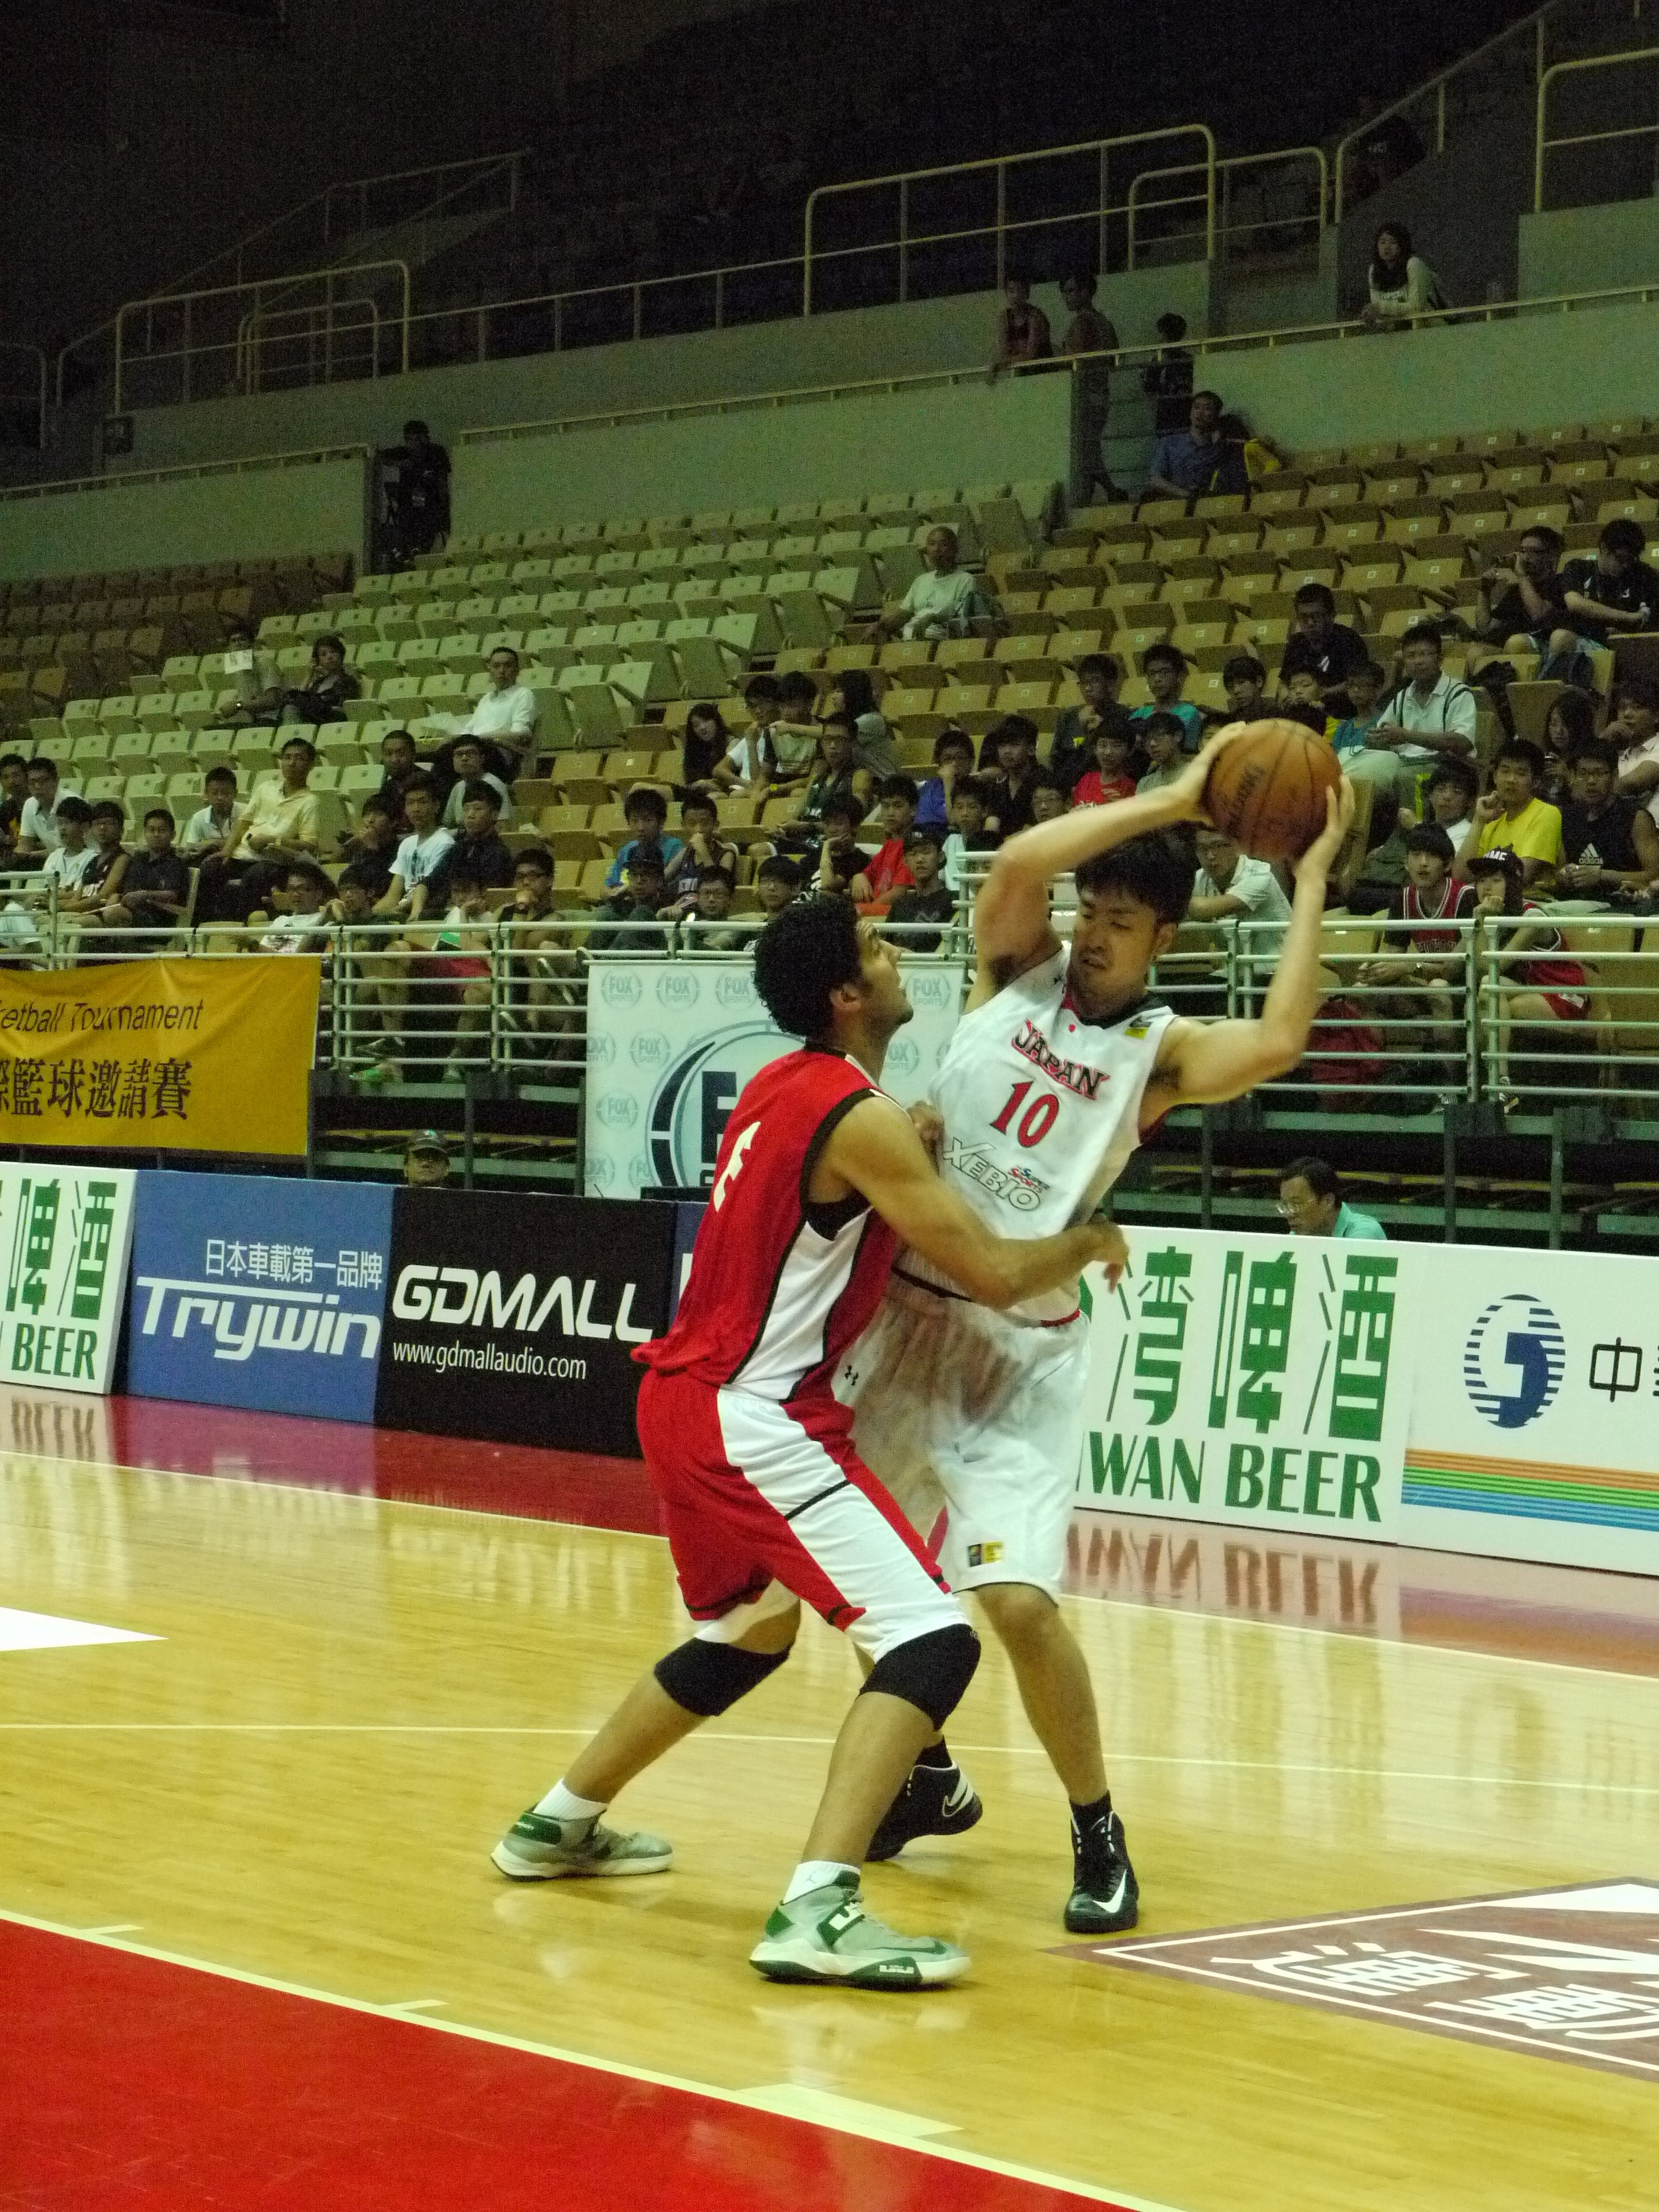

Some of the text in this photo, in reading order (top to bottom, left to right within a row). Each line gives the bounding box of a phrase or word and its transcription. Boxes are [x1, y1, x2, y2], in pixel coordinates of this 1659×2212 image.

[609, 976, 632, 994] FOX
[665, 977, 690, 994] FOX
[724, 977, 751, 994] FOX
[913, 978, 942, 997] FOX
[0, 999, 203, 1032] etball Tournament
[587, 1037, 608, 1053] OX
[639, 1037, 660, 1055] FOX
[888, 1042, 910, 1062] OX
[1011, 1018, 1110, 1100] JAPAN
[989, 1081, 1059, 1148] 10
[585, 1158, 607, 1176] OX
[943, 1136, 1041, 1211] XEBIO
[0, 1178, 117, 1320] 啤酒
[205, 1239, 383, 1290] 日本車載第一品牌
[137, 1276, 381, 1360] Trywin
[392, 1264, 653, 1343] GDMALL
[12, 1323, 98, 1380] BEER
[393, 1340, 587, 1380] www.gdmallaudio.com
[1079, 1246, 1398, 1441] 灣啤酒
[1589, 1337, 1659, 1402] 中
[1076, 1431, 1382, 1522] WAN BEER
